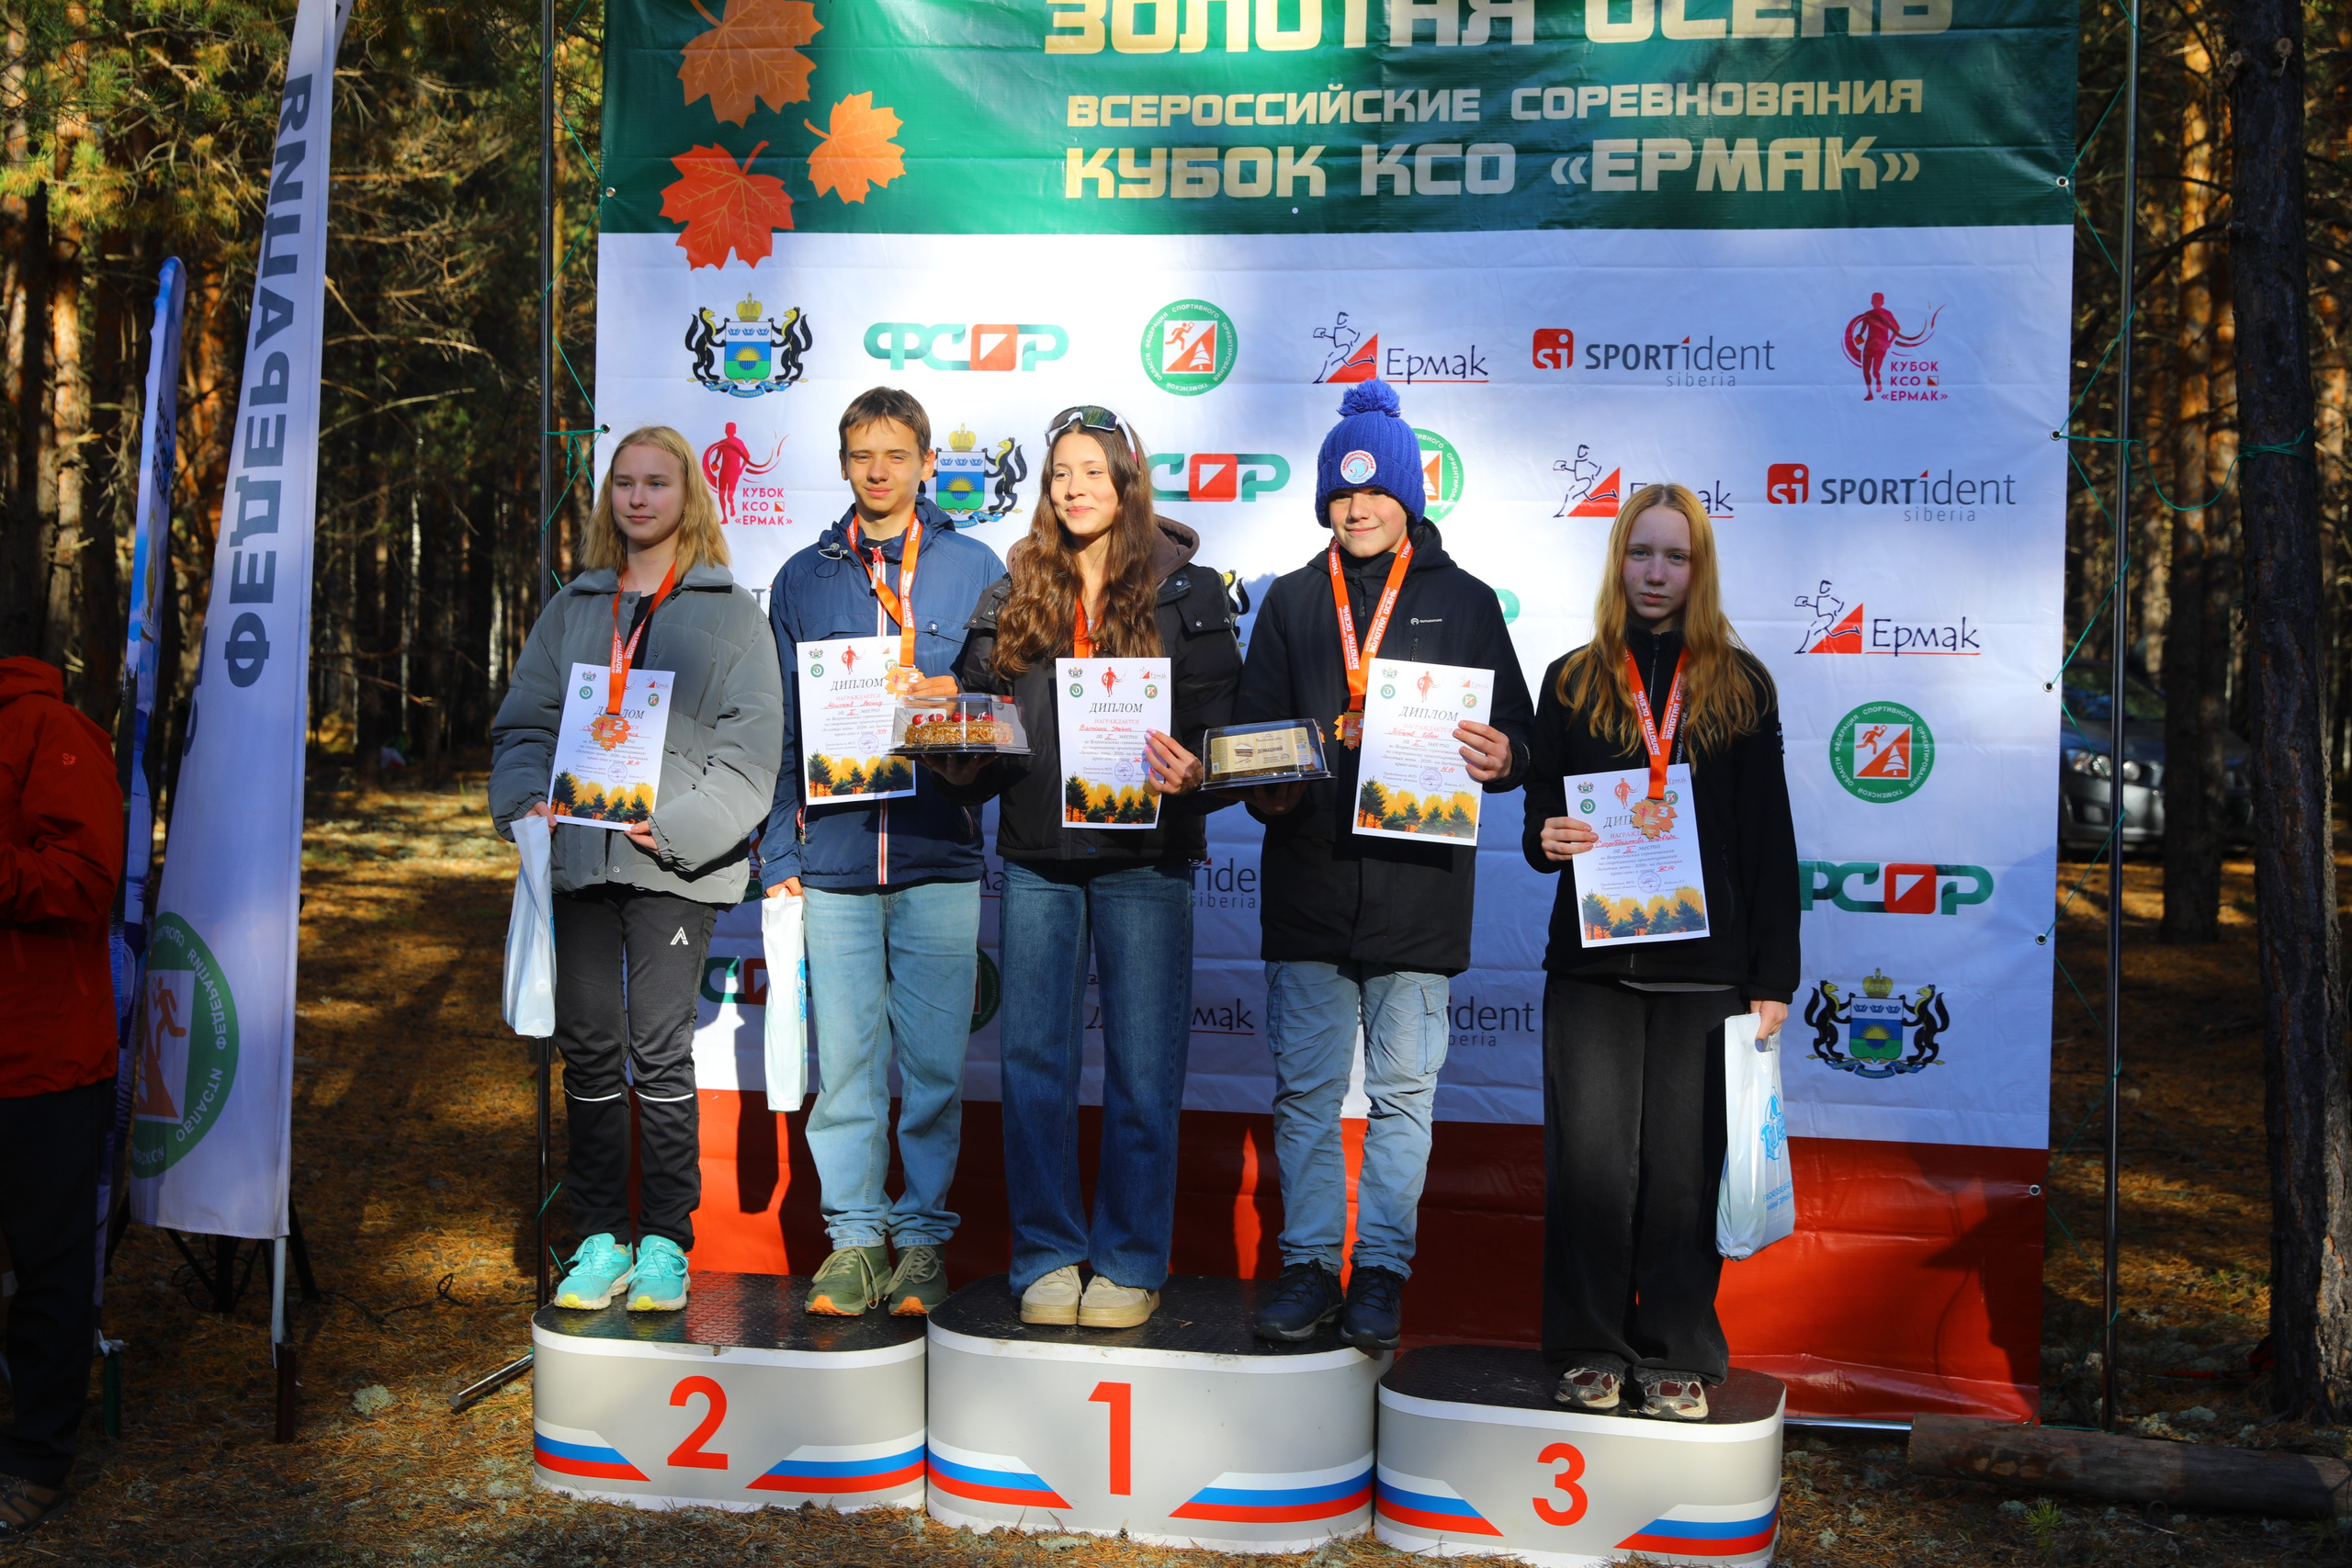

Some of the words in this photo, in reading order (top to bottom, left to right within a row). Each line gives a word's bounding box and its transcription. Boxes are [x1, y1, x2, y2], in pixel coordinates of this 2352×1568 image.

[1044, 0, 1535, 54] ЗОЛОТАЯ
[1066, 83, 1481, 128] ВСЕРОССИЙСКИЕ
[1510, 78, 1924, 121] СОРЕВНОВАНИЯ
[1064, 144, 1327, 199] КУБОК
[1360, 142, 1517, 197] КСО
[1550, 136, 1920, 192] «ЕРМАК»
[1171, 303, 1220, 319] СПОРТИВНОГО
[1145, 311, 1170, 349] ФЕДЕРАЦИЯ
[1212, 321, 1233, 382] ОРИЕНТИРОВАНИЯ
[1385, 344, 1488, 385] Ермак
[1585, 335, 1775, 371] SPORTident
[1145, 352, 1163, 381] ОБЛАСТИ
[1666, 371, 1736, 387] siberia
[1890, 361, 1939, 372] КУБОК
[1166, 381, 1209, 392] ТЮМЕНСКОЙ
[1881, 390, 1949, 401] «ЕРМАК»
[1890, 376, 1921, 387] КСО
[742, 488, 785, 499] КУБОК
[1821, 468, 2017, 506] SPORTident
[734, 515, 793, 526] «ЕРМАК»
[742, 502, 770, 513] КСО
[1904, 506, 1975, 522] siberia
[1342, 604, 1353, 632] ОСЕНЬ
[1369, 616, 1387, 653] ЗОЛОТАЯ
[1383, 589, 1397, 615] ОСЕНЬ
[1871, 615, 1981, 658] Ермак
[1347, 633, 1360, 671] ЗОЛОТАЯ
[830, 678, 884, 692] ДИПЛОМ
[1089, 703, 1143, 715] ДИПЛОМ
[1398, 705, 1459, 722] ДИПЛОМ
[1637, 690, 1650, 716] ОСЕНЬ
[1862, 705, 1915, 722] СПОРТИВНОГО
[1666, 703, 1681, 740] ЗОЛОТАЯ
[1834, 714, 1860, 752] ФЕДЕРАЦИЯ
[1645, 717, 1661, 756] ЗОЛОТАЯ
[1834, 756, 1854, 786] ОБЛАСТИ
[1907, 726, 1930, 788] ОРИЕНТИРОВАНИЯ
[1857, 786, 1904, 799] ТЮМЕНСКОЙ
[1657, 806, 1669, 818] 3
[666, 1374, 729, 1472] 2
[1088, 1382, 1132, 1497] 1
[1532, 1441, 1589, 1529] 3
